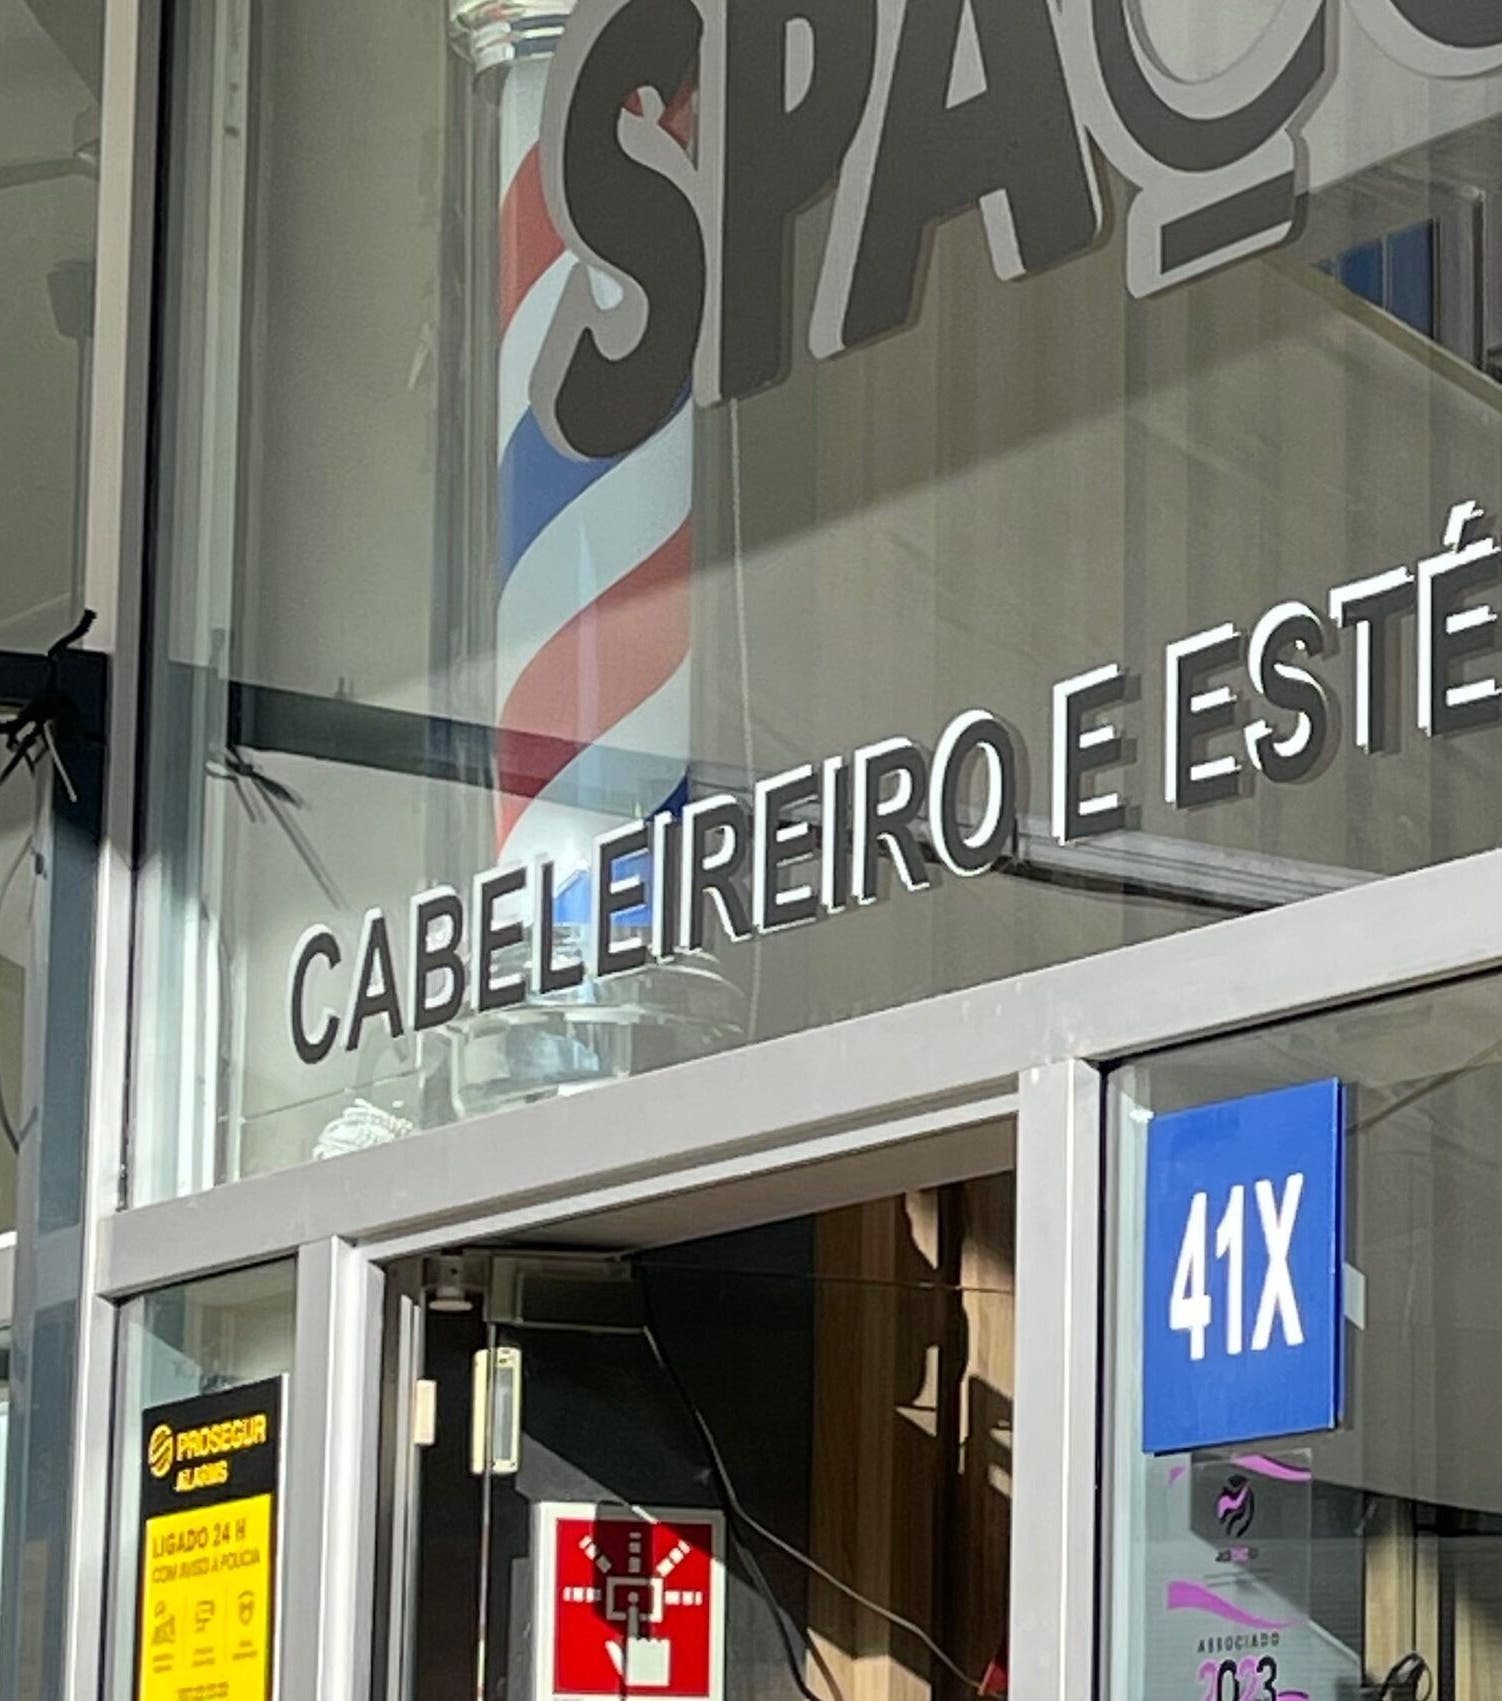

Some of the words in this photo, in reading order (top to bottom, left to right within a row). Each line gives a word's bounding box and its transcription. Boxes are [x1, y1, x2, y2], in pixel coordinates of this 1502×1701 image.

[289, 709, 1018, 1064] CABELEIREIRO
[1052, 663, 1128, 846] E
[1168, 1172, 1304, 1360] 41X
[176, 1414, 267, 1461] PROSEGUR
[152, 1526, 208, 1559] LIGADO
[212, 1522, 230, 1548] 24
[1198, 1632, 1280, 1653] ASSOCIADO
